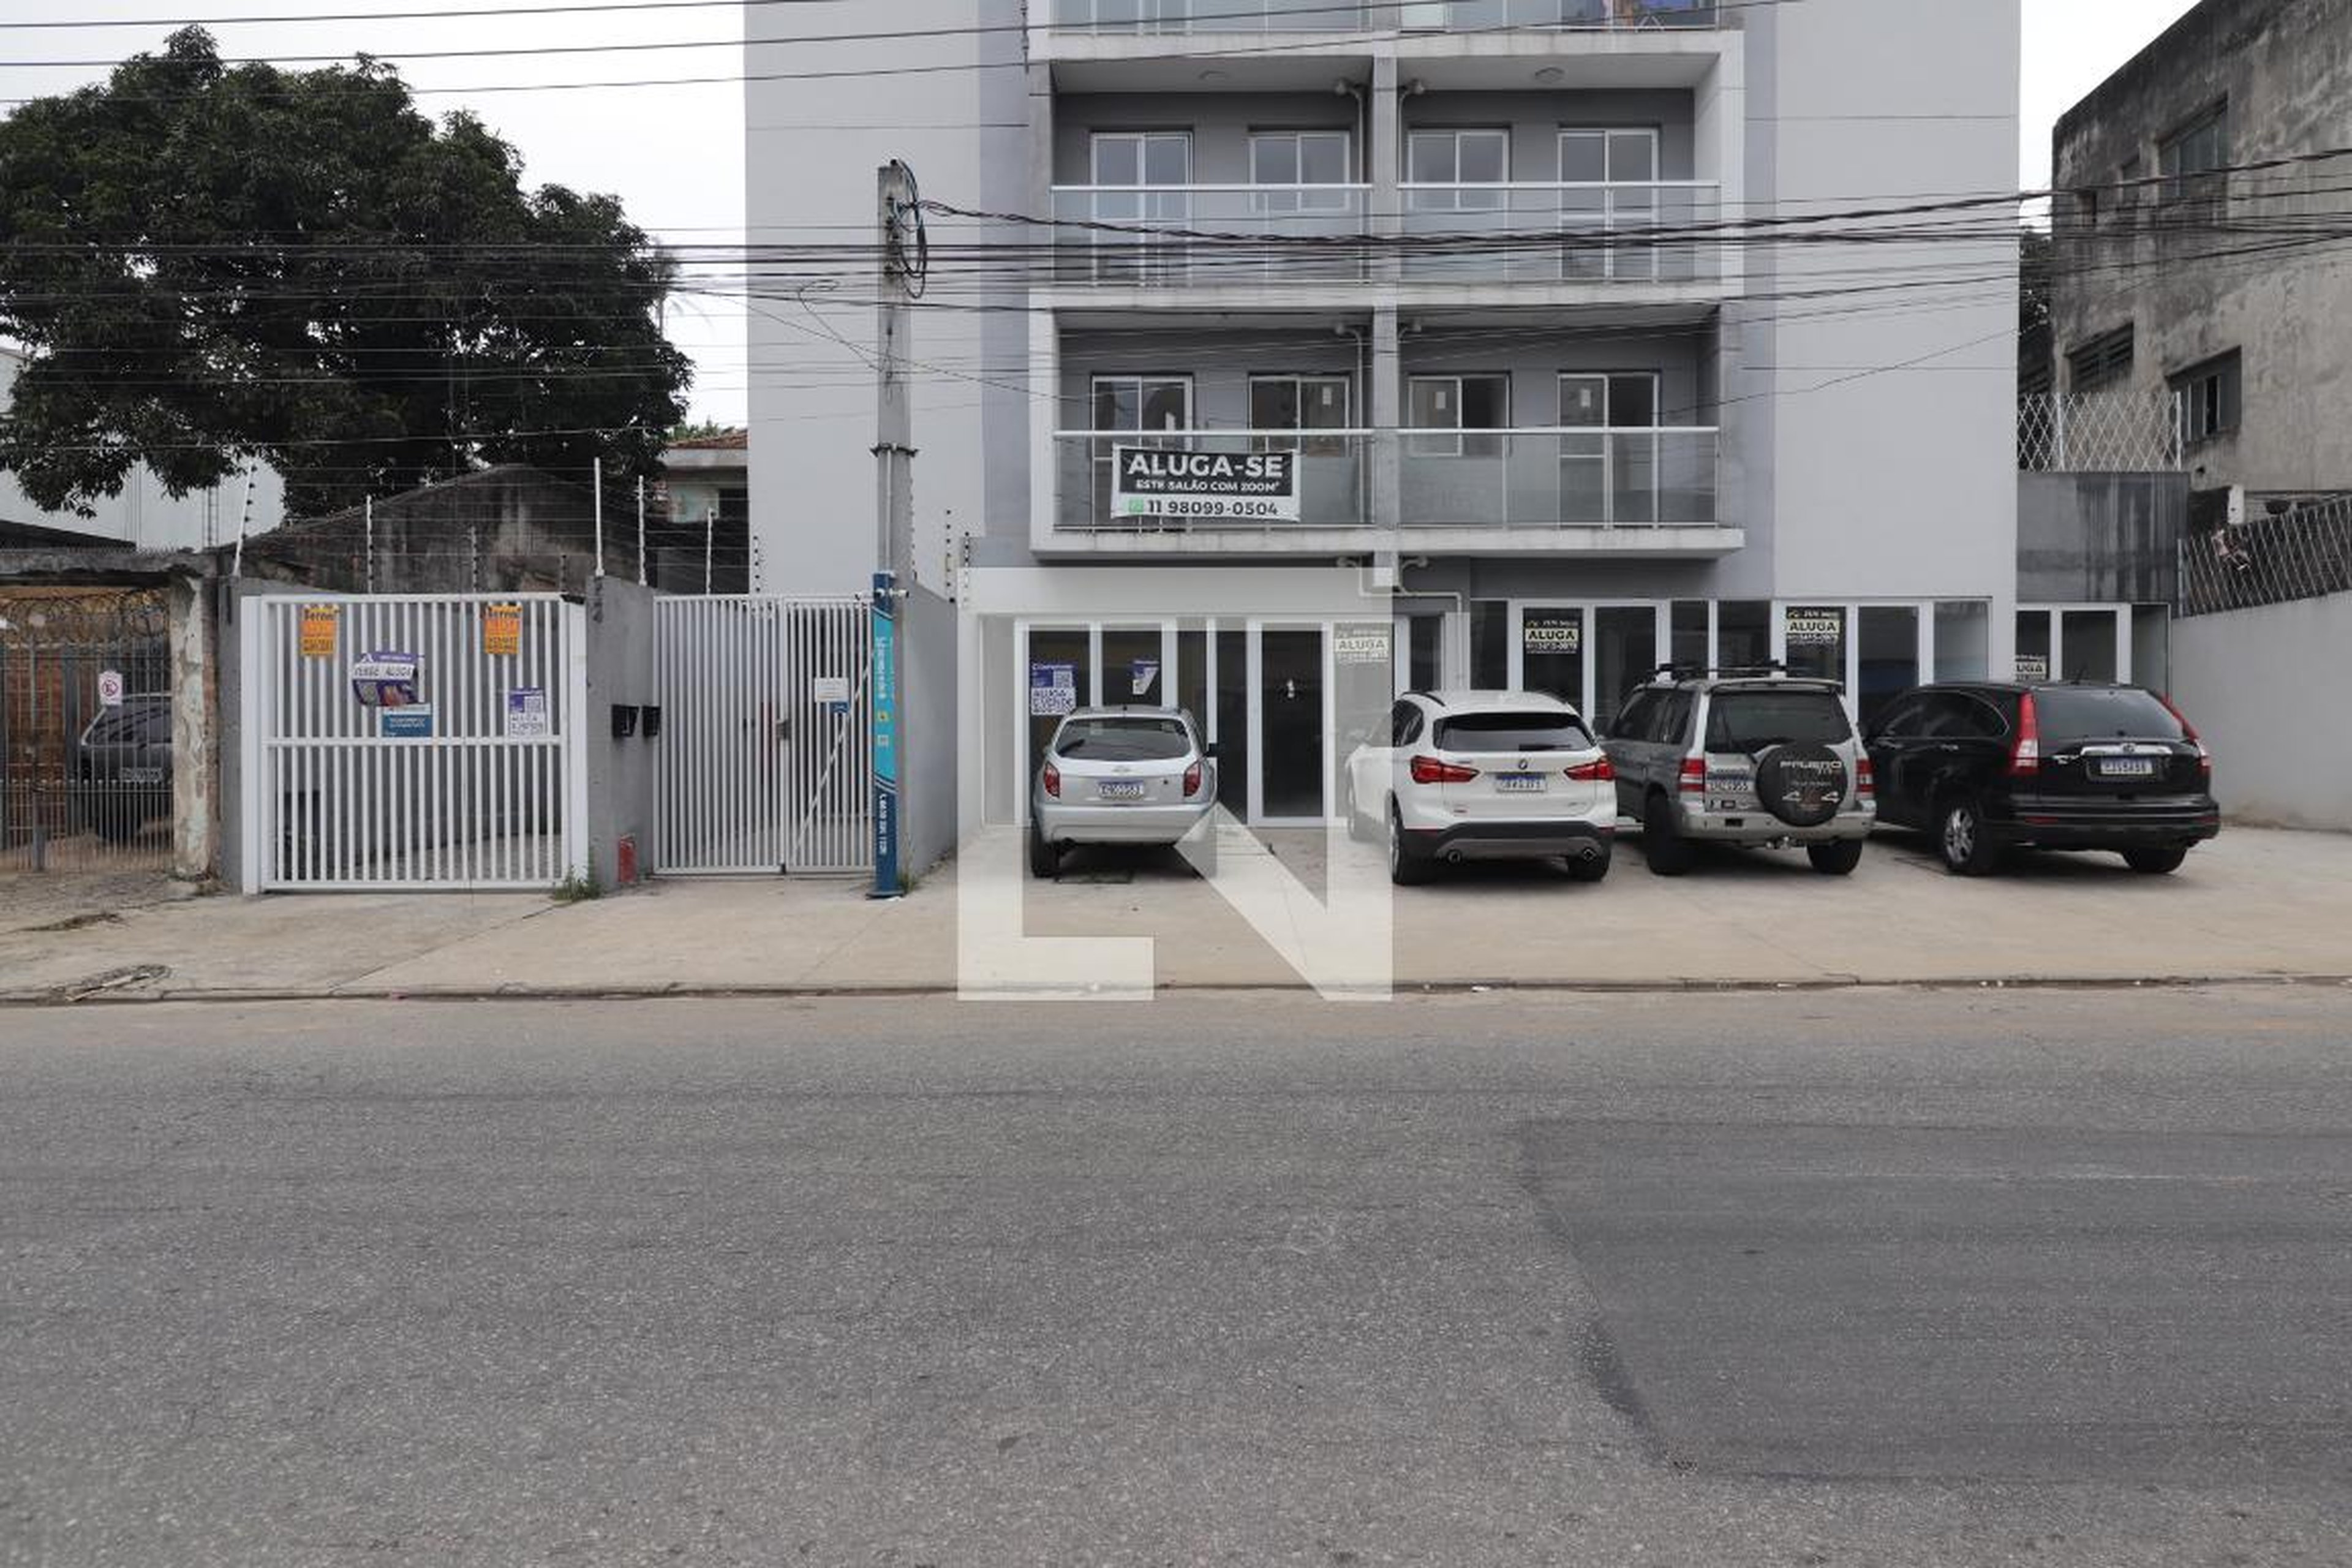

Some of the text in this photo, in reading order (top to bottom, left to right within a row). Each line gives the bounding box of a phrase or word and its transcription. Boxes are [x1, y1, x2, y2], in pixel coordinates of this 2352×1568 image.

[1128, 454, 1283, 477] ALUGA-SE
[1136, 480, 1164, 489] ESTE
[1168, 480, 1207, 491] SALÃO
[1210, 481, 1238, 491] COM
[1148, 500, 1278, 515] 11 98099-0504
[1790, 622, 1836, 631] ALUGA
[1529, 630, 1575, 640] ALUGA
[1339, 640, 1385, 650] ALUGA
